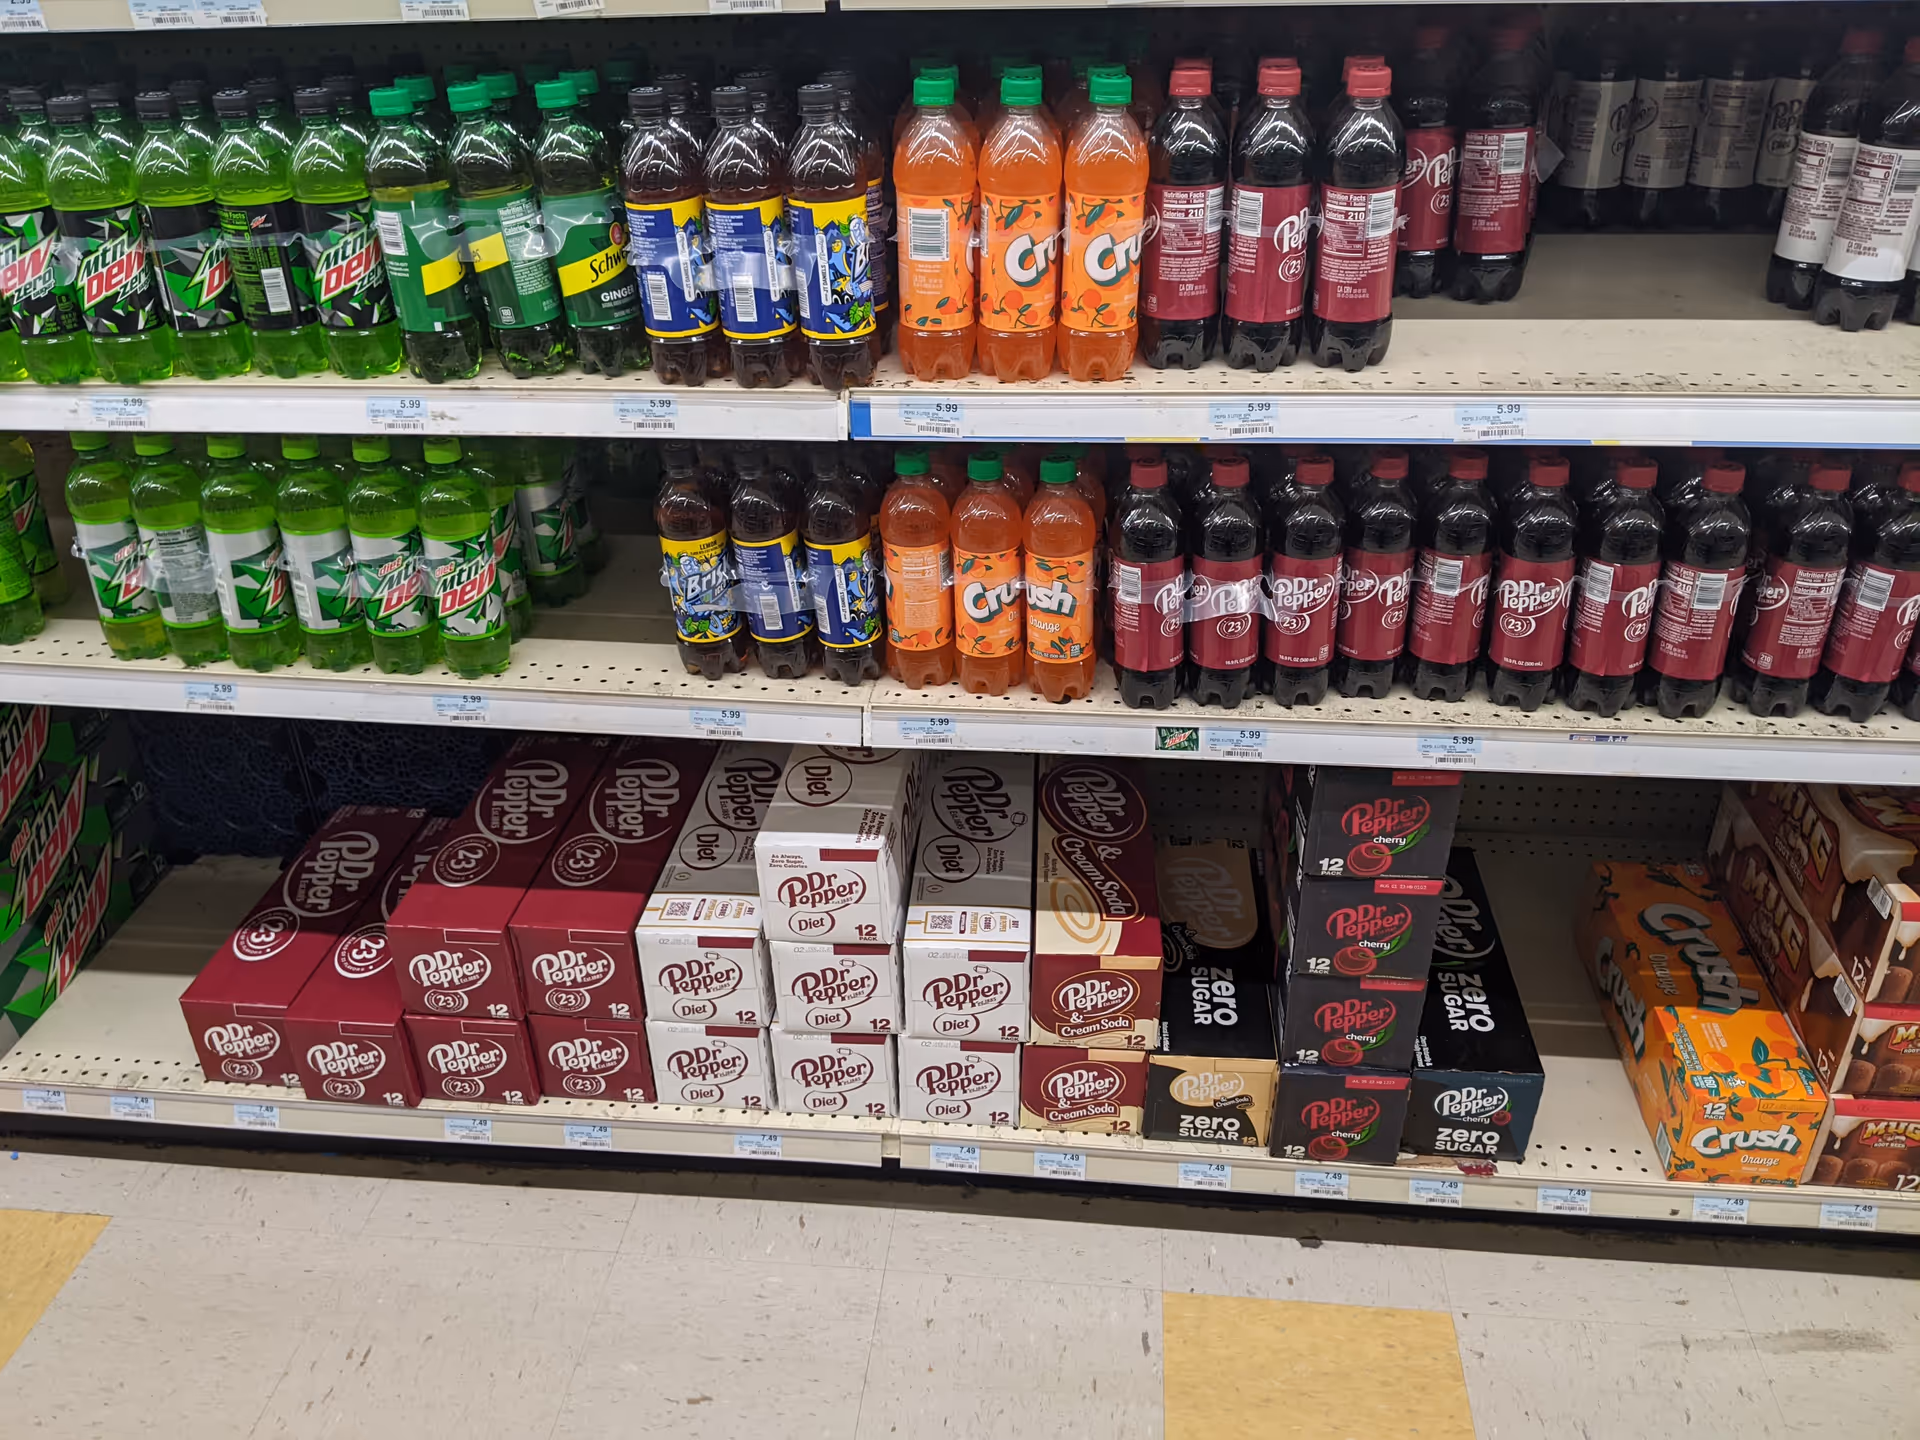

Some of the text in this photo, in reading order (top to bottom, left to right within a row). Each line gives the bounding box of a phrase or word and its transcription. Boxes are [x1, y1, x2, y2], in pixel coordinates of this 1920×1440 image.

[1189, 191, 1205, 199] Facts
[1350, 193, 1366, 201] Facts
[1188, 208, 1204, 218] 210
[1348, 211, 1365, 220] 210
[123, 398, 143, 407] 5.99
[400, 399, 421, 409] 5.99
[649, 399, 671, 408] 5.99
[935, 403, 958, 413] 5.99
[1247, 402, 1271, 412] 5.99
[1496, 404, 1521, 414] 5.99
[1293, 577, 1318, 595] Dr
[1520, 580, 1545, 595] Dr
[1677, 583, 1692, 592] 210
[1794, 586, 1833, 595] Calories 210
[1274, 578, 1331, 612] Pepper
[1500, 580, 1560, 612] Pepper
[1029, 615, 1061, 633] Orange
[1228, 620, 1242, 633] 23
[1283, 617, 1297, 629] 23
[1507, 619, 1522, 632] 23
[1760, 655, 1771, 663] 210
[214, 684, 232, 693] 5.99
[462, 695, 482, 703] 5.99
[721, 710, 740, 719] 5.99
[929, 717, 950, 726] 5.99
[1239, 730, 1261, 739] 5.99
[1452, 735, 1474, 745] 5.99
[804, 765, 833, 796] Diet
[605, 759, 681, 837] Pepper
[1373, 836, 1407, 846] cherry
[1097, 845, 1122, 860] &
[1062, 838, 1132, 914] Cream Soda
[798, 917, 825, 931] Diet
[855, 924, 877, 937] 12
[1359, 939, 1391, 950] cherry
[434, 950, 464, 970] Dr
[560, 950, 588, 970] Dr
[1640, 902, 1759, 1015] Crush
[409, 953, 485, 988] Pepper
[532, 953, 608, 986] Pepper
[685, 959, 715, 978] Dr
[1648, 953, 1679, 996] Orange
[659, 964, 736, 996] Pepper
[1085, 980, 1111, 994] Dr
[436, 994, 454, 1008] 23
[558, 992, 575, 1006] 23
[1060, 983, 1128, 1011] Pepper
[1191, 967, 1213, 1025] SUGAR
[1210, 967, 1239, 1026] zero
[1438, 972, 1470, 1032] SUGAR
[608, 1003, 630, 1015] 12
[1460, 973, 1496, 1033] zero
[487, 1003, 509, 1017] 12
[681, 1003, 708, 1017] Diet
[735, 1010, 757, 1023] 12
[815, 1013, 841, 1026] Diet
[1070, 1011, 1085, 1024] &
[870, 1019, 891, 1030] 12
[942, 1019, 970, 1032] Diet
[1061, 1017, 1129, 1037] Cream Soda
[998, 1026, 1020, 1037] 12
[1346, 1033, 1376, 1043] cherry
[1124, 1034, 1146, 1046] 12
[452, 1040, 481, 1059] Dr
[574, 1038, 602, 1057] Dr
[693, 1046, 722, 1061] Dr
[428, 1044, 500, 1075] Pepper
[548, 1042, 622, 1072] Pepper
[234, 1063, 249, 1076] 23
[1072, 1069, 1098, 1083] Dr
[453, 1081, 469, 1094] 23
[574, 1079, 591, 1092] 23
[1048, 1072, 1115, 1099] Pepper
[1704, 1075, 1718, 1089] 160
[334, 1083, 351, 1096] 23
[623, 1088, 645, 1102] 12
[690, 1089, 714, 1100] Diet
[502, 1090, 523, 1103] 12
[812, 1096, 838, 1108] Diet
[1058, 1097, 1072, 1109] &
[1216, 1096, 1250, 1109] Cream Soda
[935, 1104, 962, 1116] Diet
[989, 1111, 1009, 1122] 12
[1049, 1103, 1115, 1121] Cream Soda
[471, 1118, 488, 1126] 7.49
[1180, 1114, 1240, 1132] zero
[1462, 1116, 1490, 1125] cherry
[591, 1125, 608, 1133] 7.49
[1179, 1127, 1239, 1141] SUGAR
[1331, 1130, 1361, 1139] cherry
[1436, 1127, 1500, 1144] zero
[761, 1134, 778, 1142] 7.49
[1691, 1124, 1799, 1156] Crush
[1434, 1141, 1498, 1155] SUGAR
[1063, 1153, 1080, 1161] 7.49
[1741, 1154, 1780, 1167] Orange
[1208, 1163, 1225, 1171] 7.49
[1324, 1172, 1342, 1180] 7.49
[1440, 1181, 1459, 1189] 7.49
[1726, 1198, 1744, 1206] 7.49
[1854, 1205, 1873, 1213] 7.49
